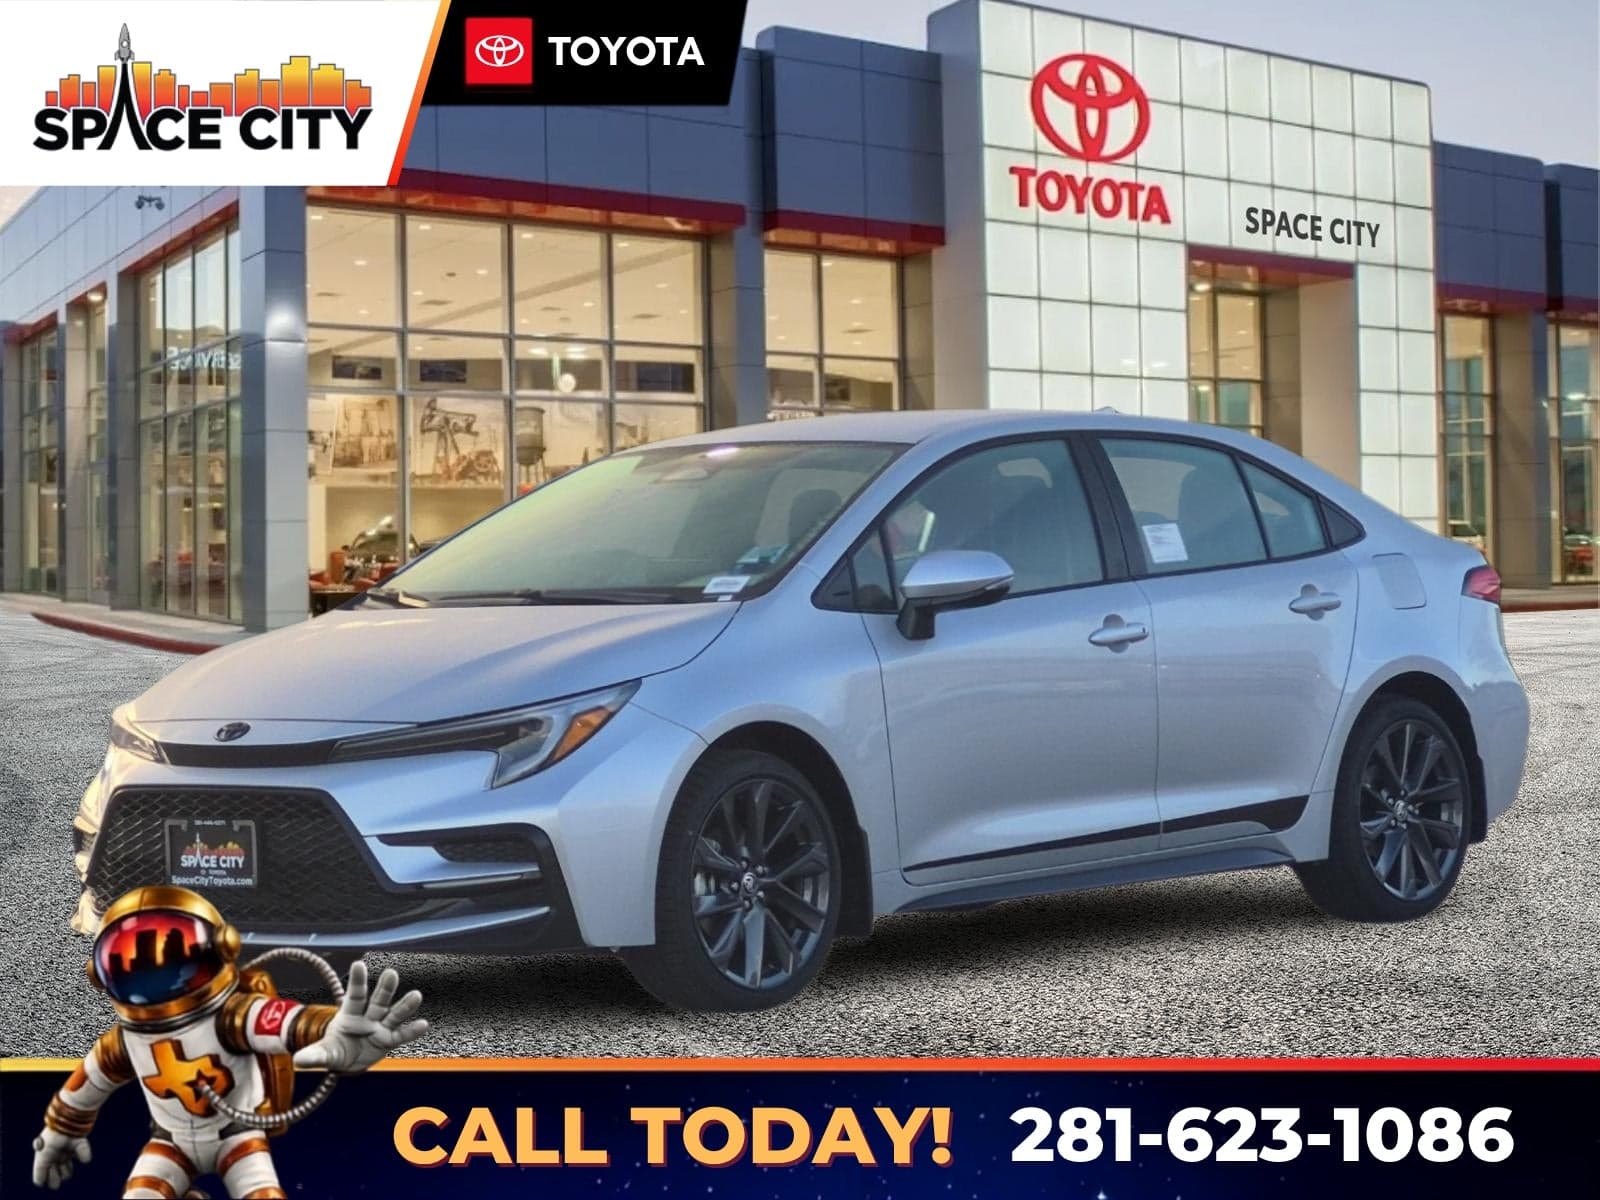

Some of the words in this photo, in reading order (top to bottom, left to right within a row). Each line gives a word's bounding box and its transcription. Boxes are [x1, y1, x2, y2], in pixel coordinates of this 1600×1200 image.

[1009, 166, 1171, 224] TOYOTA
[1245, 207, 1323, 242] SPACE
[1329, 218, 1381, 248] CITY
[181, 849, 217, 868] SPACE
[219, 856, 245, 868] CITY
[172, 875, 253, 887] SpaceCityToyota.com
